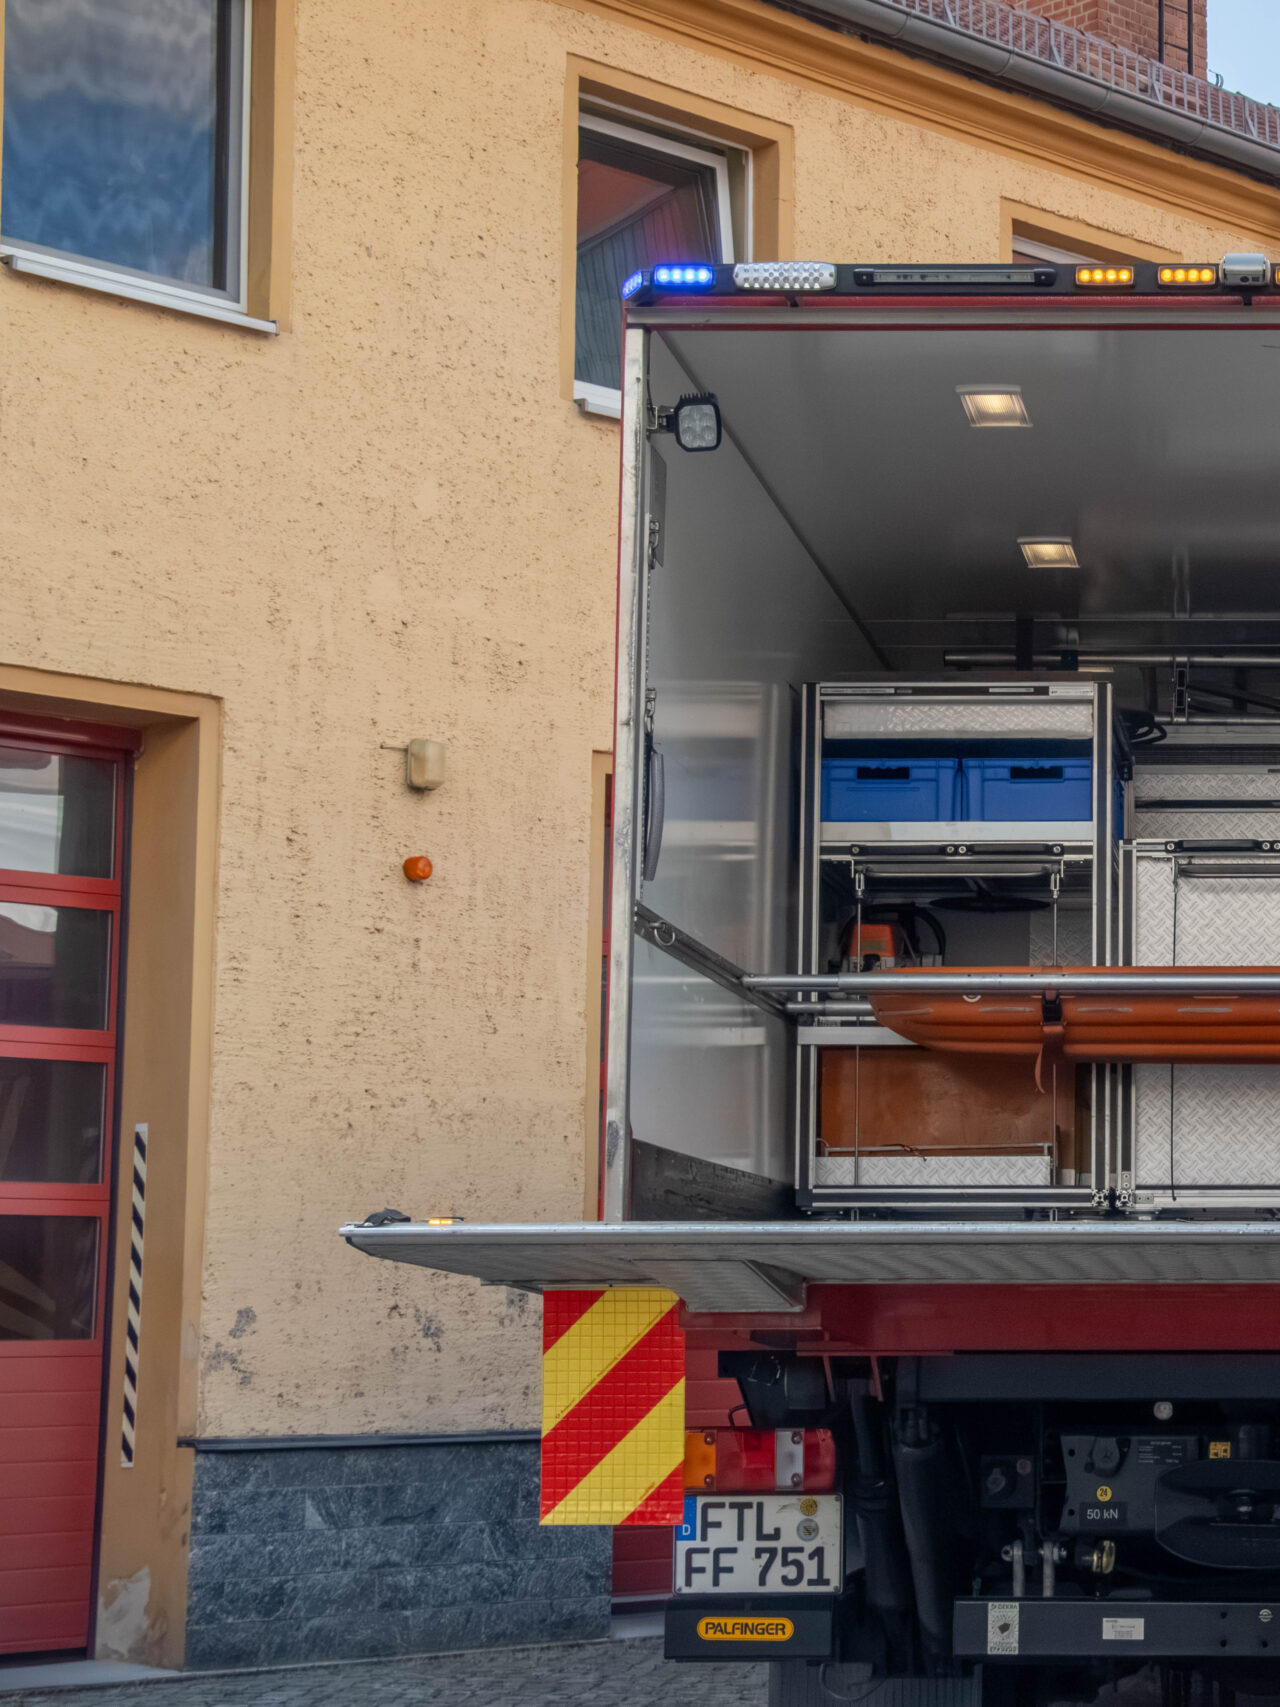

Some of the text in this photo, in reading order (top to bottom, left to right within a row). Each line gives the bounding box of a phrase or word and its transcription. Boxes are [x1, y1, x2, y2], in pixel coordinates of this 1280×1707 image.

[1100, 1488, 1108, 1497] 24
[1087, 1508, 1118, 1520] 50 kN
[700, 1502, 781, 1541] FTL
[682, 1525, 691, 1536] D
[685, 1546, 831, 1587] FF 751
[705, 1622, 786, 1636] PALFINGER
